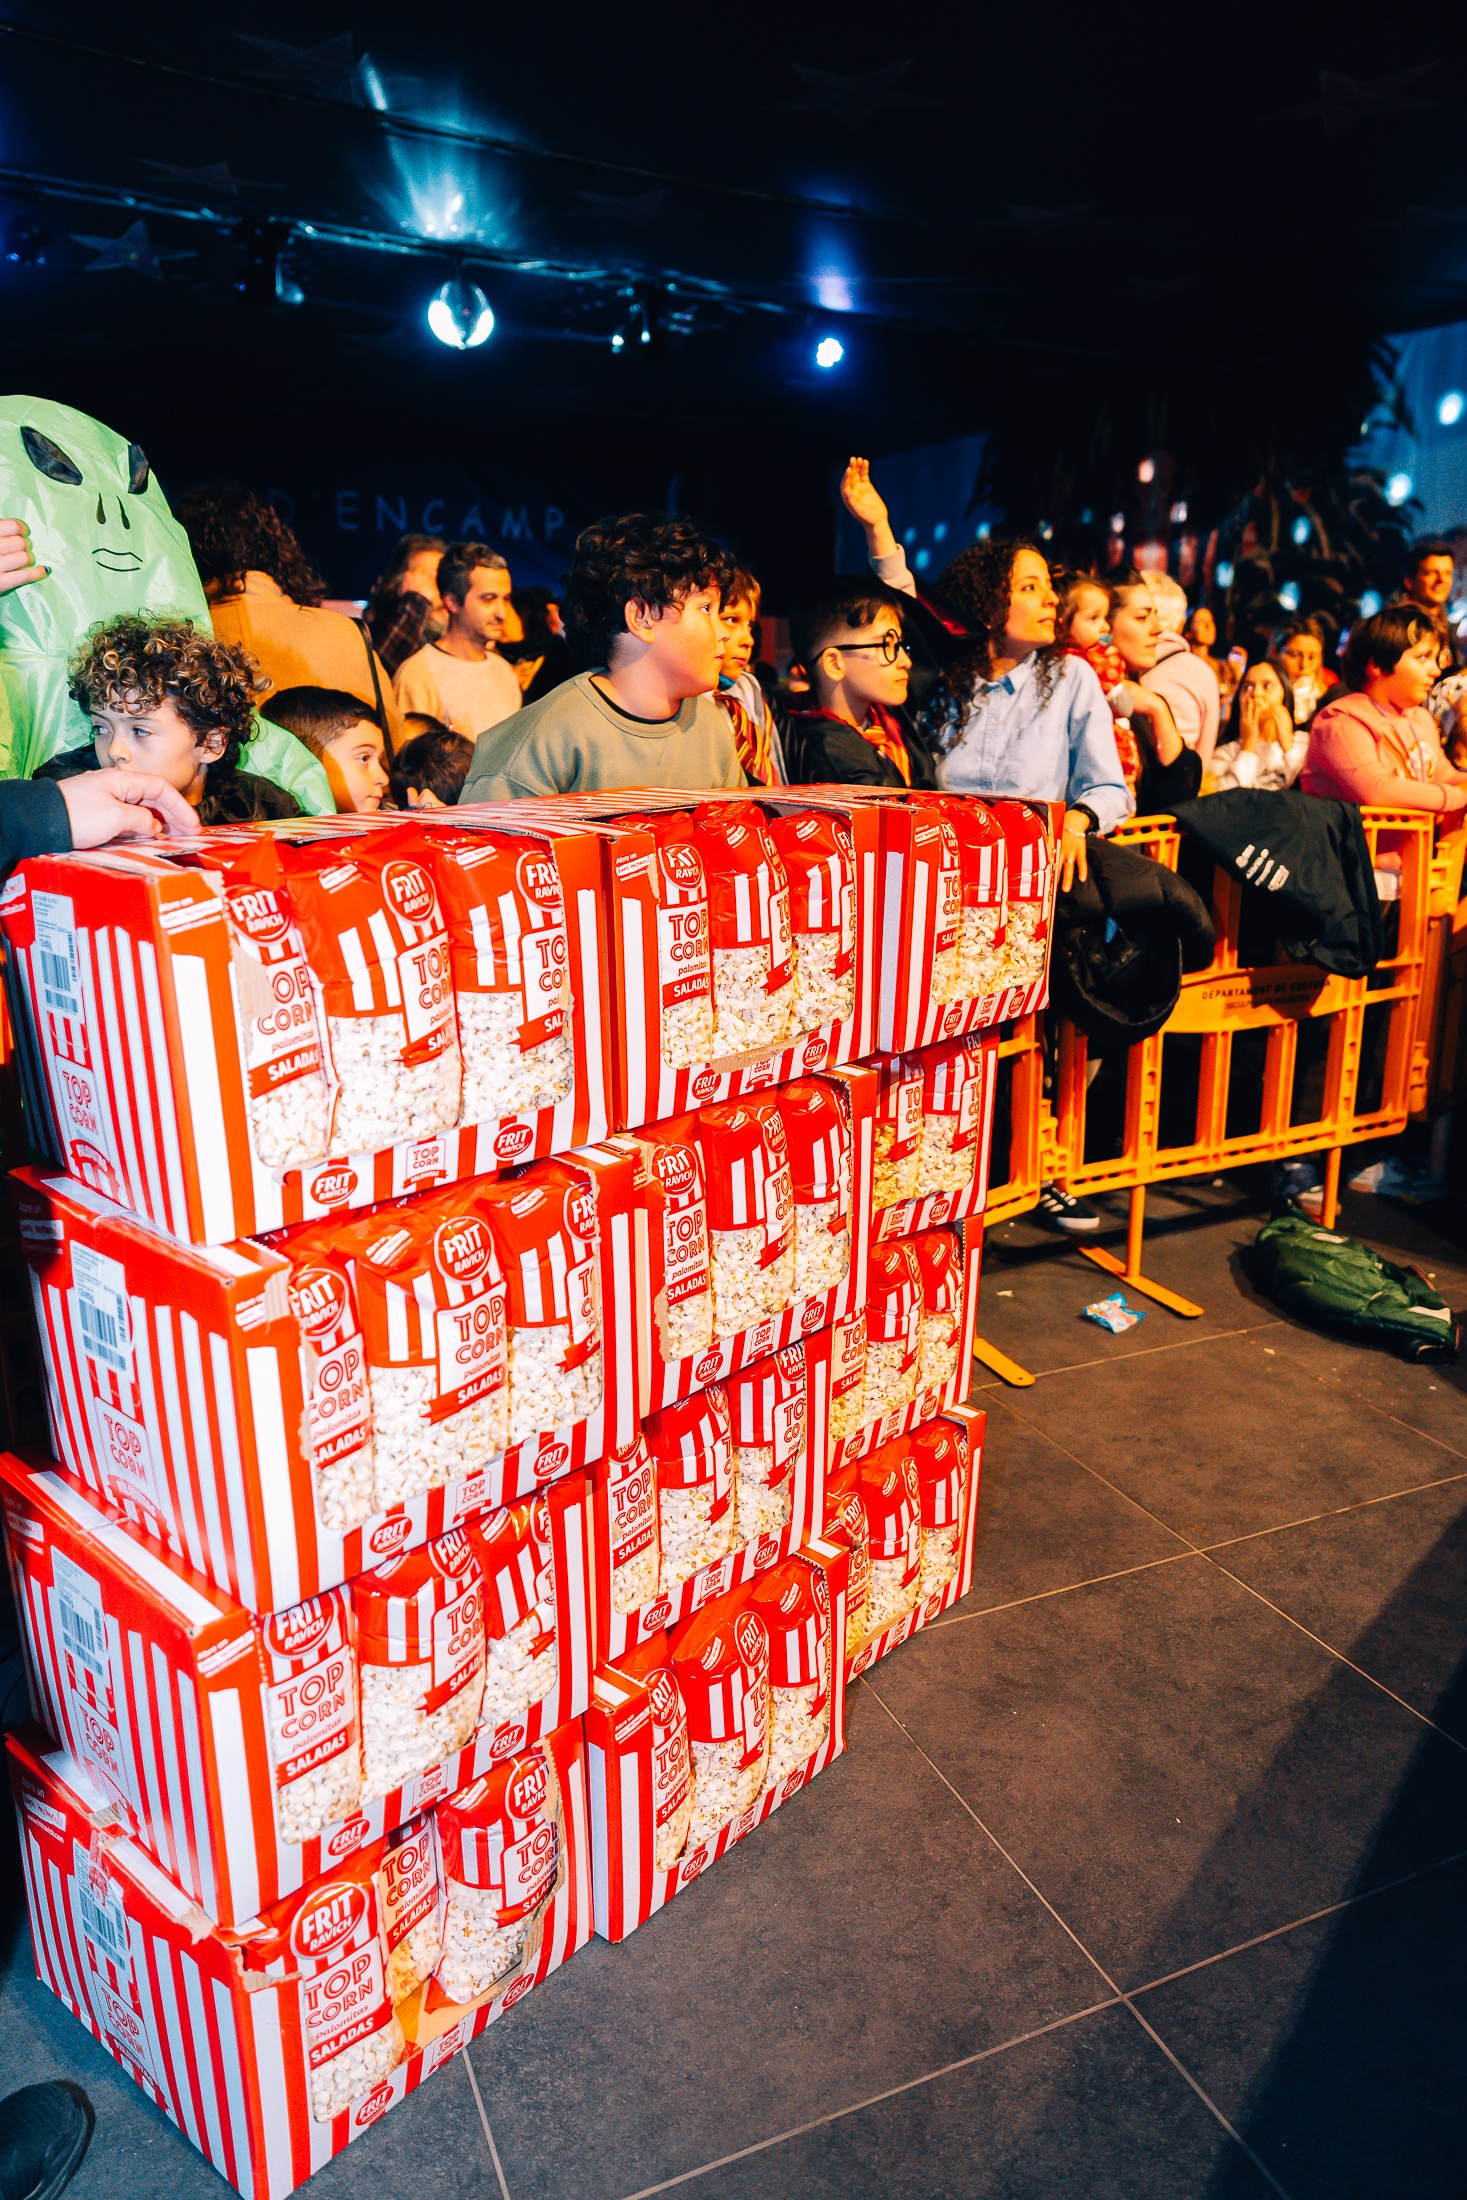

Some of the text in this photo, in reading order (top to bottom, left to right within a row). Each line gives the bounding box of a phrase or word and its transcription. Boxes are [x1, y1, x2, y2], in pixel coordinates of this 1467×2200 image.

[390, 868, 426, 903] FRIT
[526, 862, 559, 888] FRI
[944, 874, 960, 898] TO
[403, 893, 430, 914] RAVICH
[535, 884, 561, 899] RAVIC
[230, 890, 278, 921] FRIT
[668, 908, 708, 941] TOP
[536, 934, 566, 969] TO
[272, 966, 310, 1004] OP
[538, 966, 566, 992] CO
[673, 976, 709, 998] SALADAS
[805, 1041, 826, 1056] FRIT
[806, 1053, 822, 1064] RAVICH
[754, 1062, 770, 1073] CORN
[62, 1070, 92, 1109] TOP
[695, 1073, 718, 1090] FRIT
[696, 1085, 715, 1096] RAVICH
[498, 1128, 530, 1149] FRIT
[500, 1142, 525, 1155] RAVICH
[413, 1146, 439, 1161] TOP
[413, 1156, 439, 1170] CORN
[657, 1148, 691, 1179] FRIT
[315, 1172, 353, 1194] FRIT
[665, 1168, 692, 1188] RAVICH
[319, 1187, 348, 1202] RAVICH
[931, 1202, 949, 1215] FRIT
[443, 1222, 483, 1264] FRIT
[454, 1249, 485, 1275] RAVICH
[671, 1257, 704, 1281] palomitas
[667, 1274, 707, 1301] SALADAS
[454, 1295, 505, 1342] TOP
[803, 1306, 821, 1323] FRIT
[754, 1336, 771, 1346] CORN
[755, 1328, 772, 1341] TOP
[698, 1355, 719, 1374] FRIT
[780, 1341, 805, 1369] FRI
[787, 1359, 805, 1377] RAVIC
[319, 1348, 360, 1393] OP
[457, 1367, 504, 1403] SALADAS
[784, 1397, 805, 1427] TO
[103, 1412, 141, 1457] TOP
[783, 1422, 801, 1444] CO
[110, 1445, 147, 1482] CORN
[537, 1444, 566, 1469] FRIT
[462, 1478, 486, 1496] TOP
[462, 1487, 486, 1504] CORN
[613, 1467, 651, 1512] TOP
[614, 1490, 654, 1529] CORN
[373, 1519, 408, 1546] FRIT
[622, 1513, 653, 1541] palomitas
[618, 1526, 655, 1560] SALADAS
[756, 1543, 776, 1561] FRIT
[704, 1579, 722, 1592] CORN
[705, 1570, 722, 1584] TOP
[645, 1604, 669, 1626] FRIT
[284, 1616, 325, 1650] RAVICH
[447, 1617, 483, 1656] COR
[740, 1615, 760, 1656] FRIT
[278, 1661, 344, 1717] TOP
[751, 1675, 768, 1712] TO
[80, 1704, 116, 1752] TOP
[281, 1690, 346, 1739] CORN
[292, 1716, 341, 1753] palomitas
[492, 1728, 520, 1753] FRIT
[85, 1732, 120, 1779] CORN
[285, 1731, 346, 1777] SALADAS
[418, 1782, 443, 1798] CORN
[419, 1771, 443, 1790] TOP
[521, 1788, 547, 1815] RAVIC
[331, 1824, 364, 1850] FRIT
[382, 1831, 429, 1887] TOP
[684, 1854, 704, 1876] FRIT
[386, 1860, 432, 1907] CORN
[394, 1882, 429, 1919] palomitas
[302, 1888, 354, 1944] FRIT
[392, 1893, 432, 1941] SALADAS
[310, 1914, 352, 1951] RAVICH
[305, 1953, 371, 2011] TOP
[505, 1976, 530, 2002] FRIT
[100, 1985, 139, 2037] TOP
[306, 1979, 374, 2028] CORN
[107, 2012, 146, 2059] CORN
[315, 2004, 369, 2041] palomitas
[310, 2016, 374, 2064] SALADAS
[438, 2029, 461, 2050] TOP
[358, 2088, 388, 2121] FRIT
